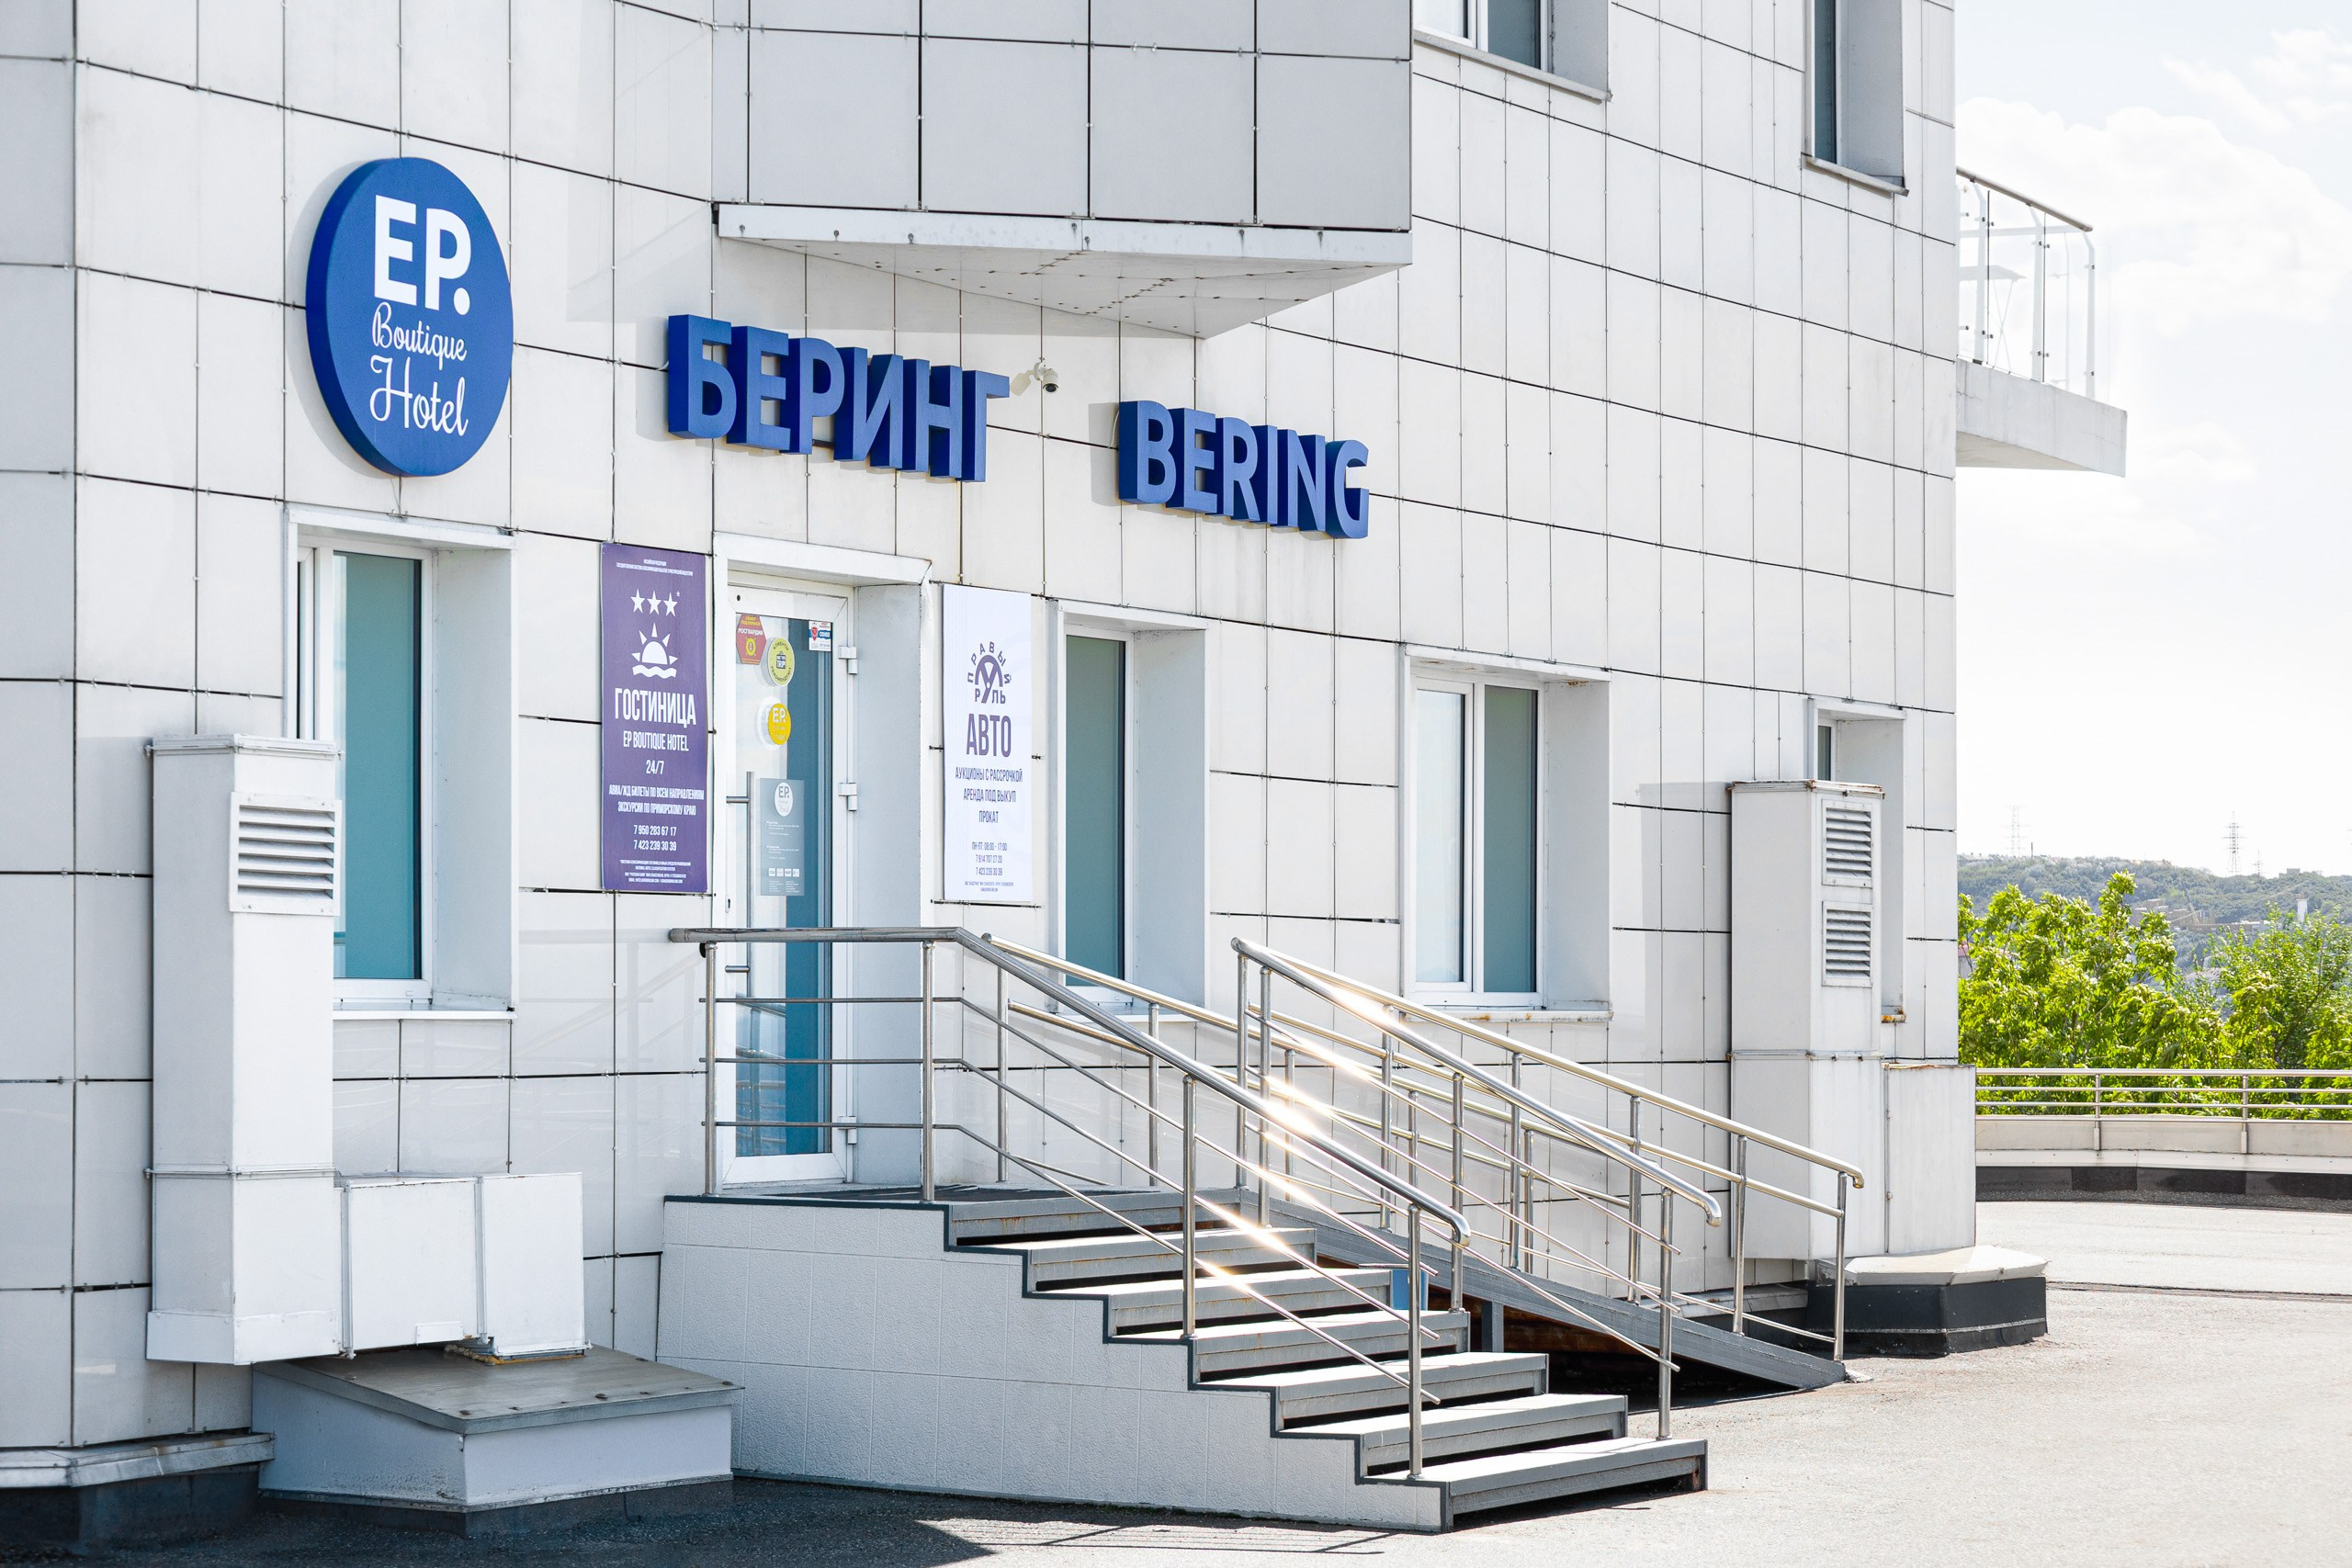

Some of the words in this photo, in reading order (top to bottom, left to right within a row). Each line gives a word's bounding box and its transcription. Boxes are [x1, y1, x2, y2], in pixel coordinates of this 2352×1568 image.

[374, 194, 471, 315] EP.
[372, 302, 467, 370] Boutique
[370, 355, 469, 436] Hotel
[668, 314, 1010, 483] БЕРИНГ
[1119, 400, 1370, 539] BERING
[967, 641, 1012, 684] ПРАВЫЙ
[615, 688, 697, 728] ГОСТИНИЦА
[623, 730, 633, 748] EP
[633, 731, 666, 750] BOUTIQUE
[667, 734, 689, 752] HOTEL
[966, 713, 1012, 758] АВТО
[646, 760, 664, 774] 24/7
[956, 766, 984, 781] АУКЦИОНЫ
[986, 769, 989, 781] С
[990, 768, 1023, 783] РАССРОЧКОЙ
[609, 784, 631, 797] АВИА/ЖД
[631, 785, 650, 797] БИЛЕТЫ
[650, 787, 656, 797] ПО
[657, 787, 669, 798] ВСЕМ
[670, 788, 704, 800] НАПРАВЛЕНИЯМ
[963, 788, 984, 802] АРЕНДА
[985, 789, 997, 803] ПОД
[998, 790, 1016, 803] ВЫКУП
[617, 801, 643, 813] ЭКСКУРСИИ
[644, 803, 650, 813] ПО
[650, 803, 683, 815] ПРИМОРСКОМУ
[683, 805, 696, 816] КРАЮ
[978, 810, 999, 823] ПРОКАТ
[634, 825, 638, 835] 7
[638, 825, 649, 835] 950
[650, 826, 661, 836] 283
[662, 826, 669, 836] 67
[670, 827, 676, 837] 17
[634, 840, 638, 850] 7
[638, 840, 649, 851] 423
[650, 840, 661, 851] 239
[662, 841, 669, 851] 30
[670, 841, 676, 852] 39
